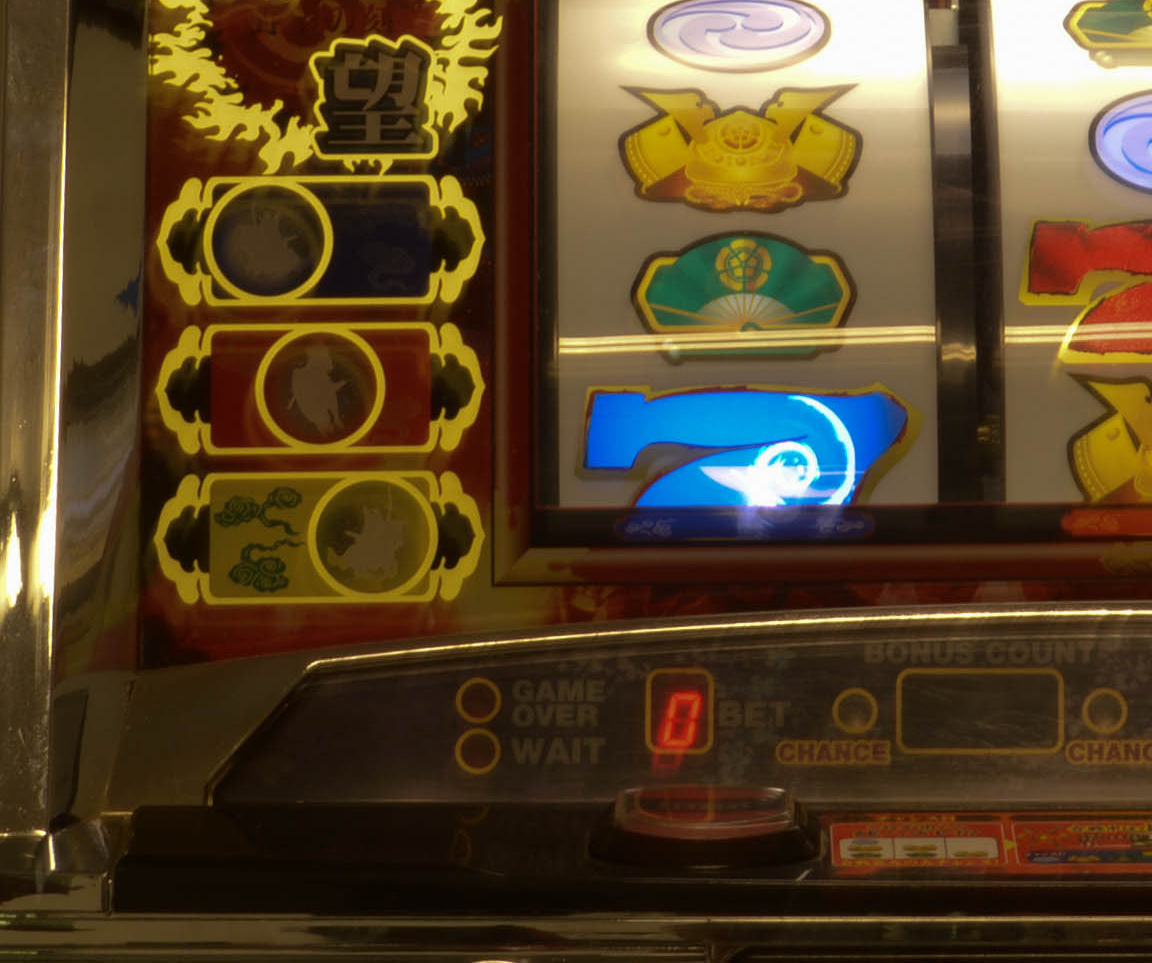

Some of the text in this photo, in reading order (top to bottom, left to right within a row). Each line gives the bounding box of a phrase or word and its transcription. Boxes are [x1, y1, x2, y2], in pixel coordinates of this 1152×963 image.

[864, 642, 1097, 665] BONUS COUNT
[511, 679, 607, 703] GAME
[511, 704, 600, 728] OVER
[662, 691, 701, 748] 0
[718, 701, 792, 728] BET
[511, 737, 606, 765] WAIT
[777, 739, 891, 765] CHANCE
